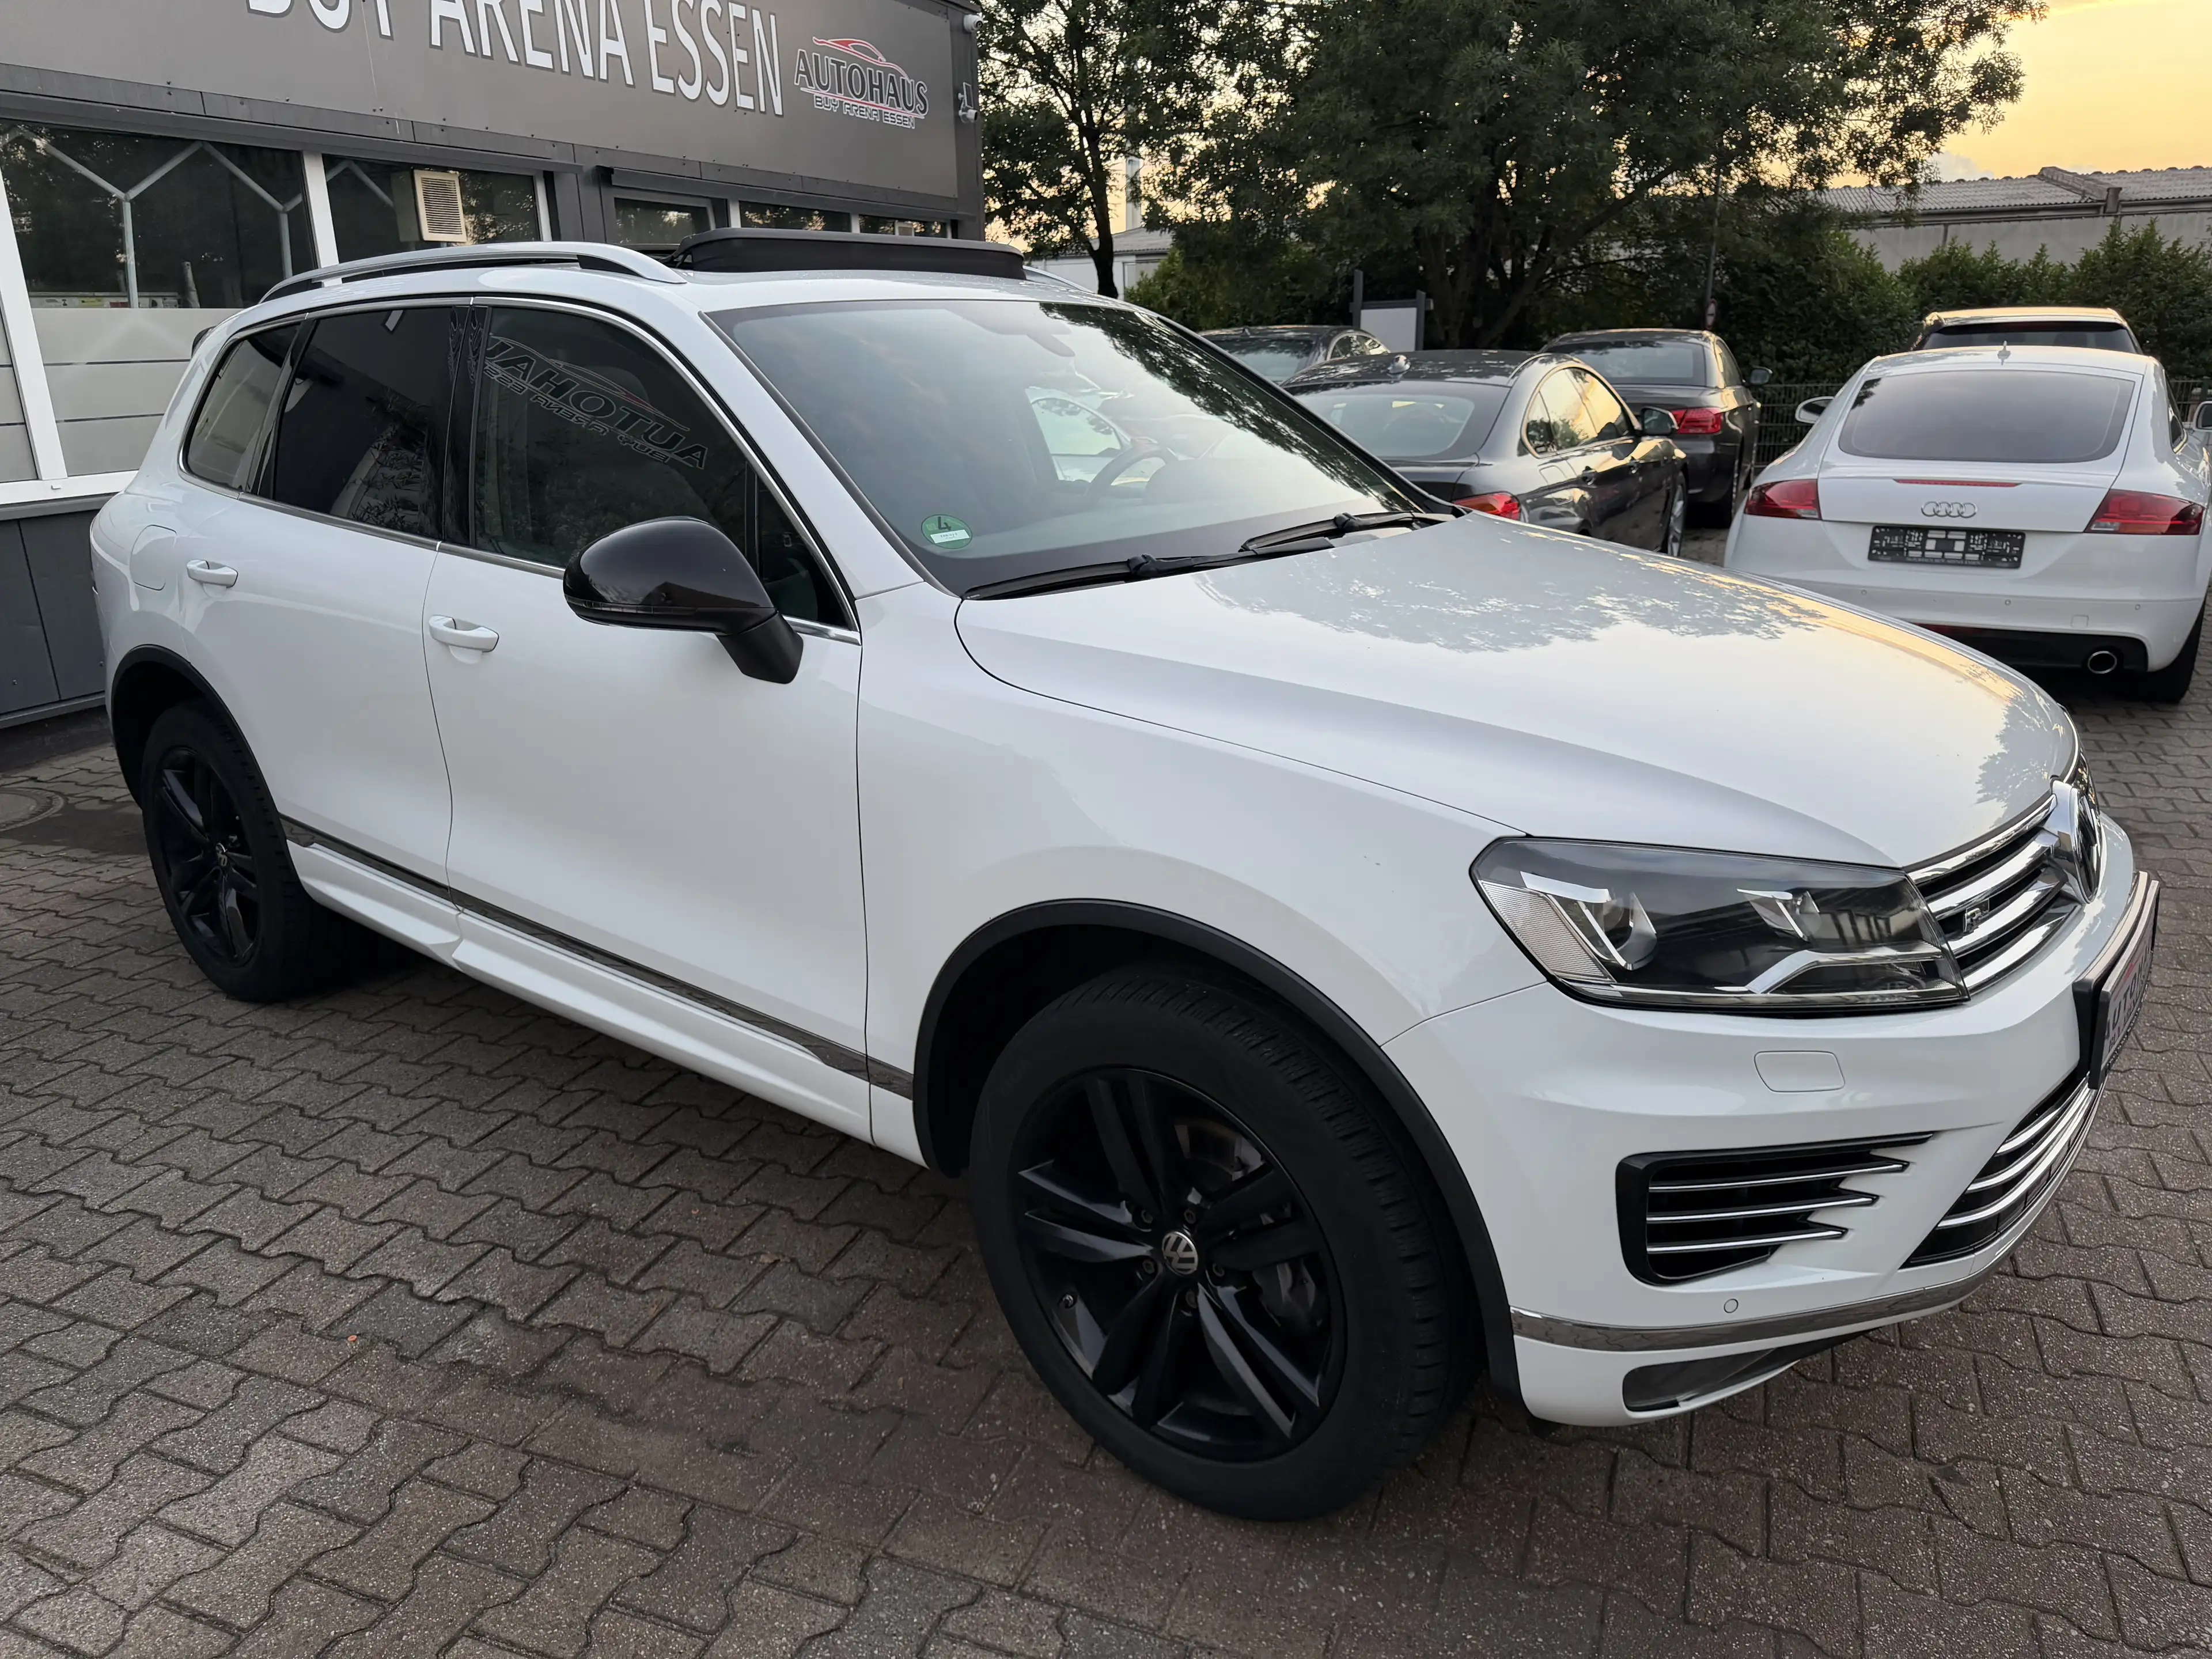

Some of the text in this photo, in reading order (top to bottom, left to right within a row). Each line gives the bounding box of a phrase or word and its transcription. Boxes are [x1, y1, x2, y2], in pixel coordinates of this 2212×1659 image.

[643, 0, 784, 116] ESSEN
[794, 48, 929, 116] AUTOHAUS
[814, 94, 916, 129] BUY ARENA ESSEN
